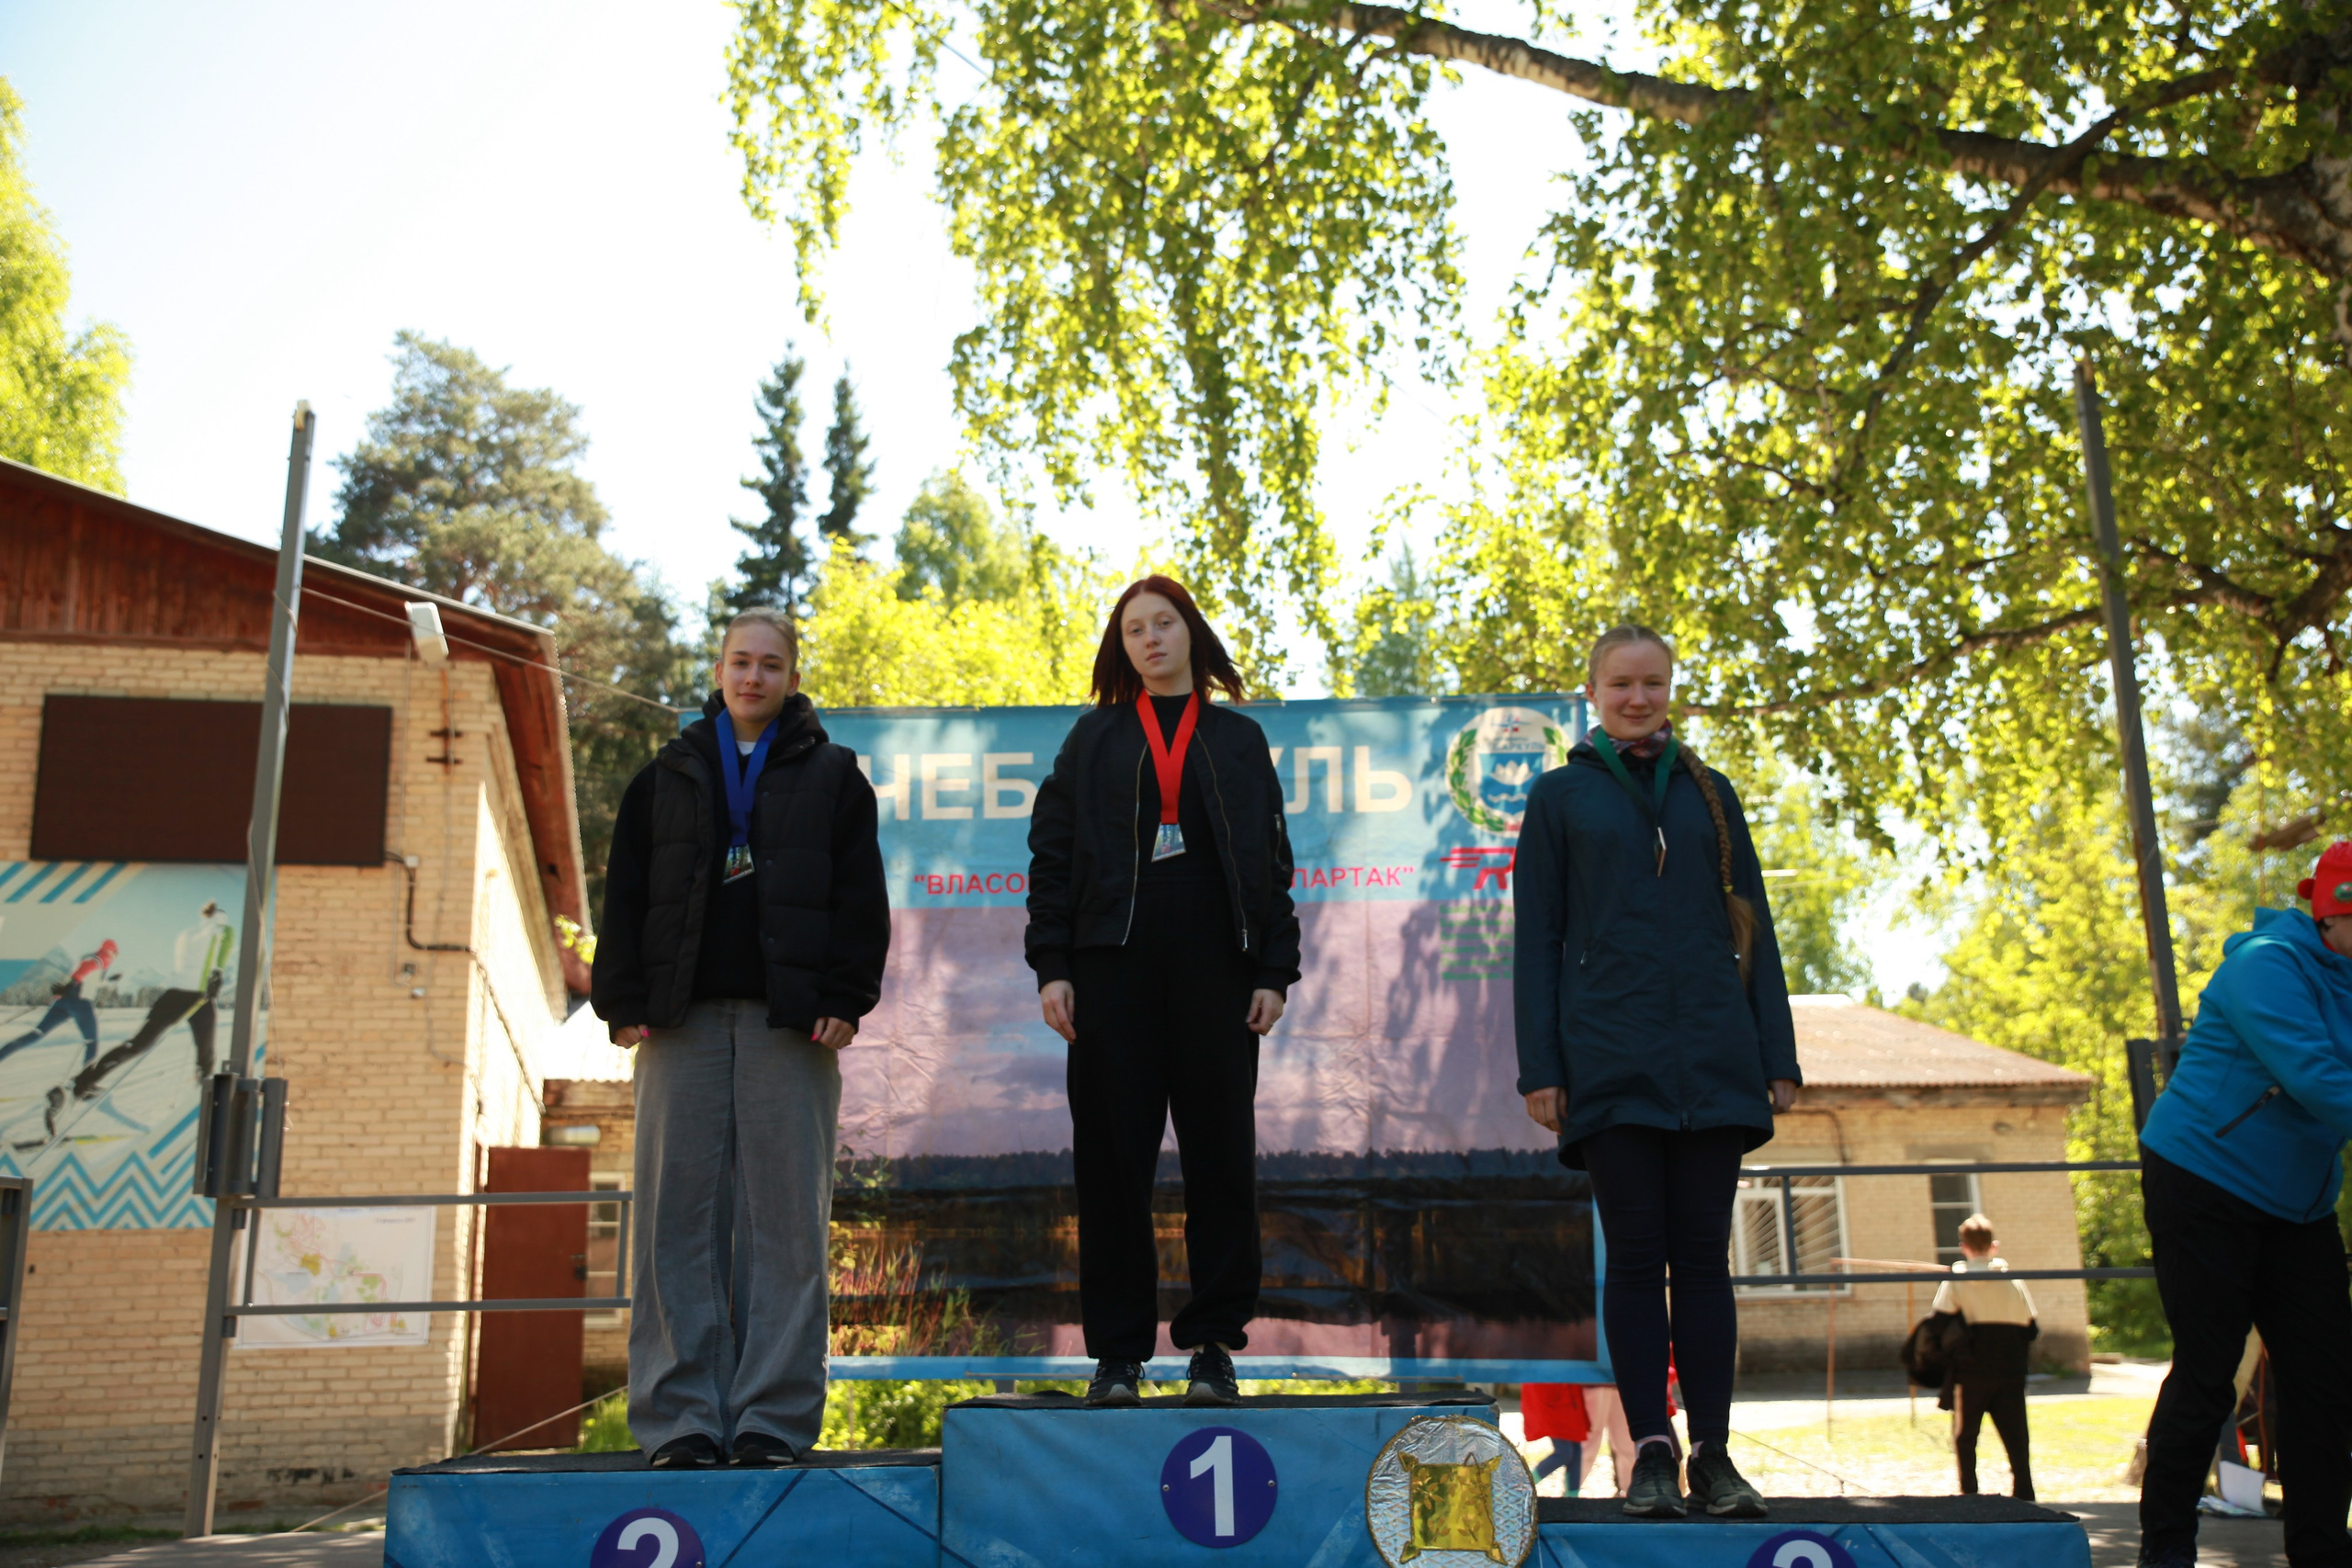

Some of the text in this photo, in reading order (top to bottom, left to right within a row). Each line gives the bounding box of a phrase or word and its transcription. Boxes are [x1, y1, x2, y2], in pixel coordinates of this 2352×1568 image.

[913, 866, 1414, 896] "ВЛАСО ПАРТАК"
[1190, 1436, 1235, 1537] 1
